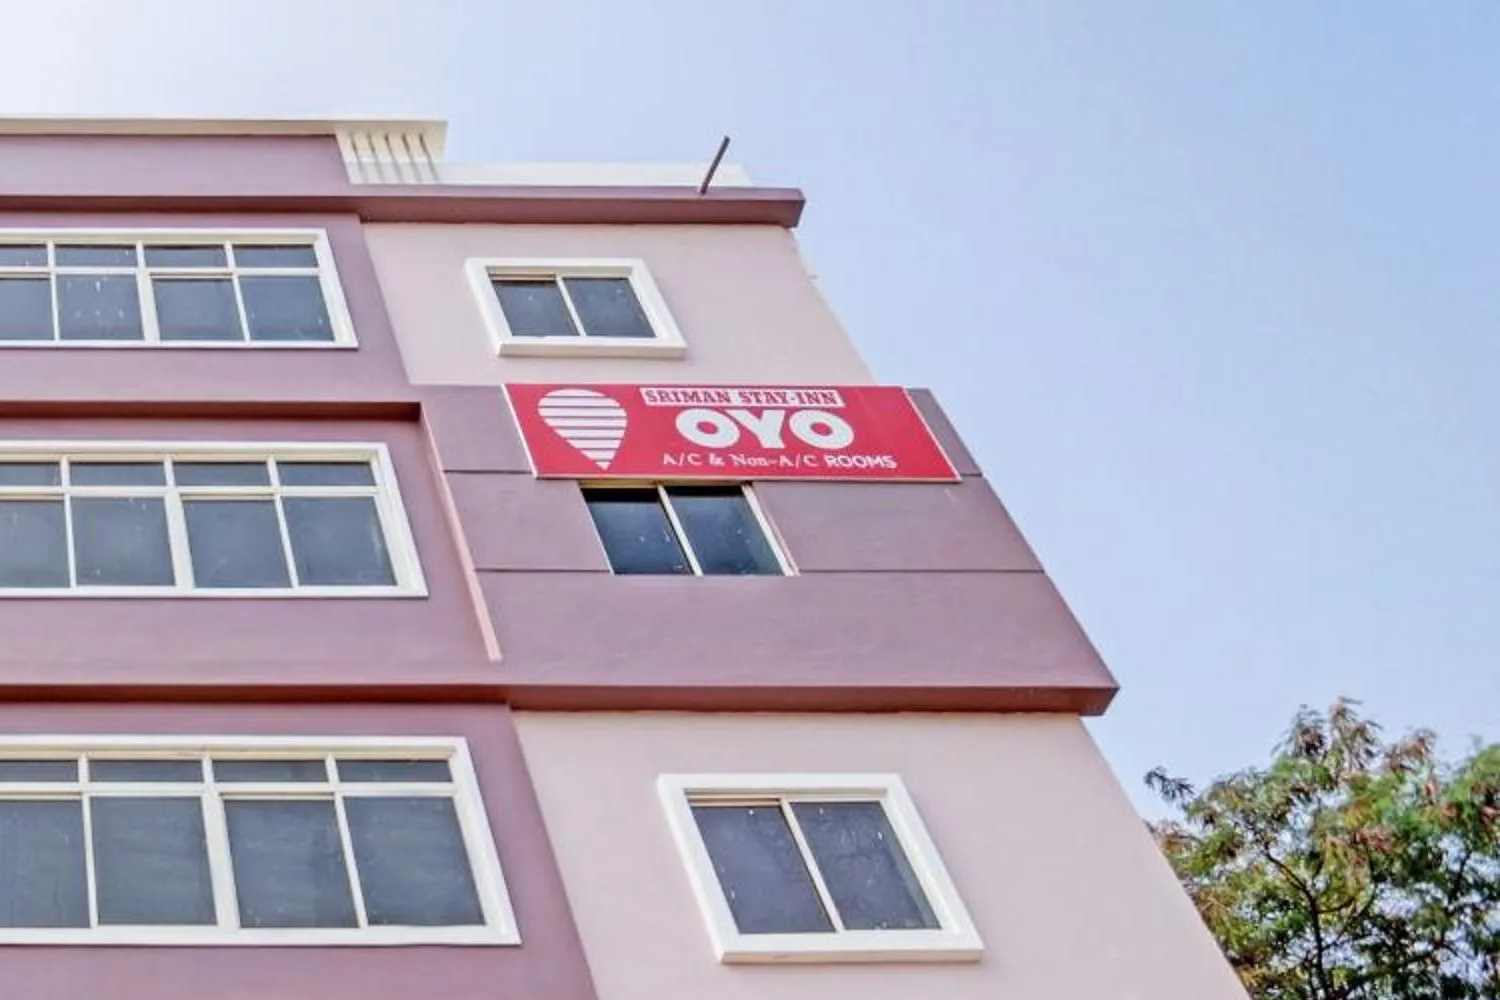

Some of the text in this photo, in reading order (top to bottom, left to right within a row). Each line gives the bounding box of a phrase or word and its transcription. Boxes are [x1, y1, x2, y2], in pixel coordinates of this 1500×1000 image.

[645, 389, 732, 404] SRIMAN
[675, 407, 855, 450] OYO
[663, 453, 898, 469] A/C & Non-A/C ROOMS
